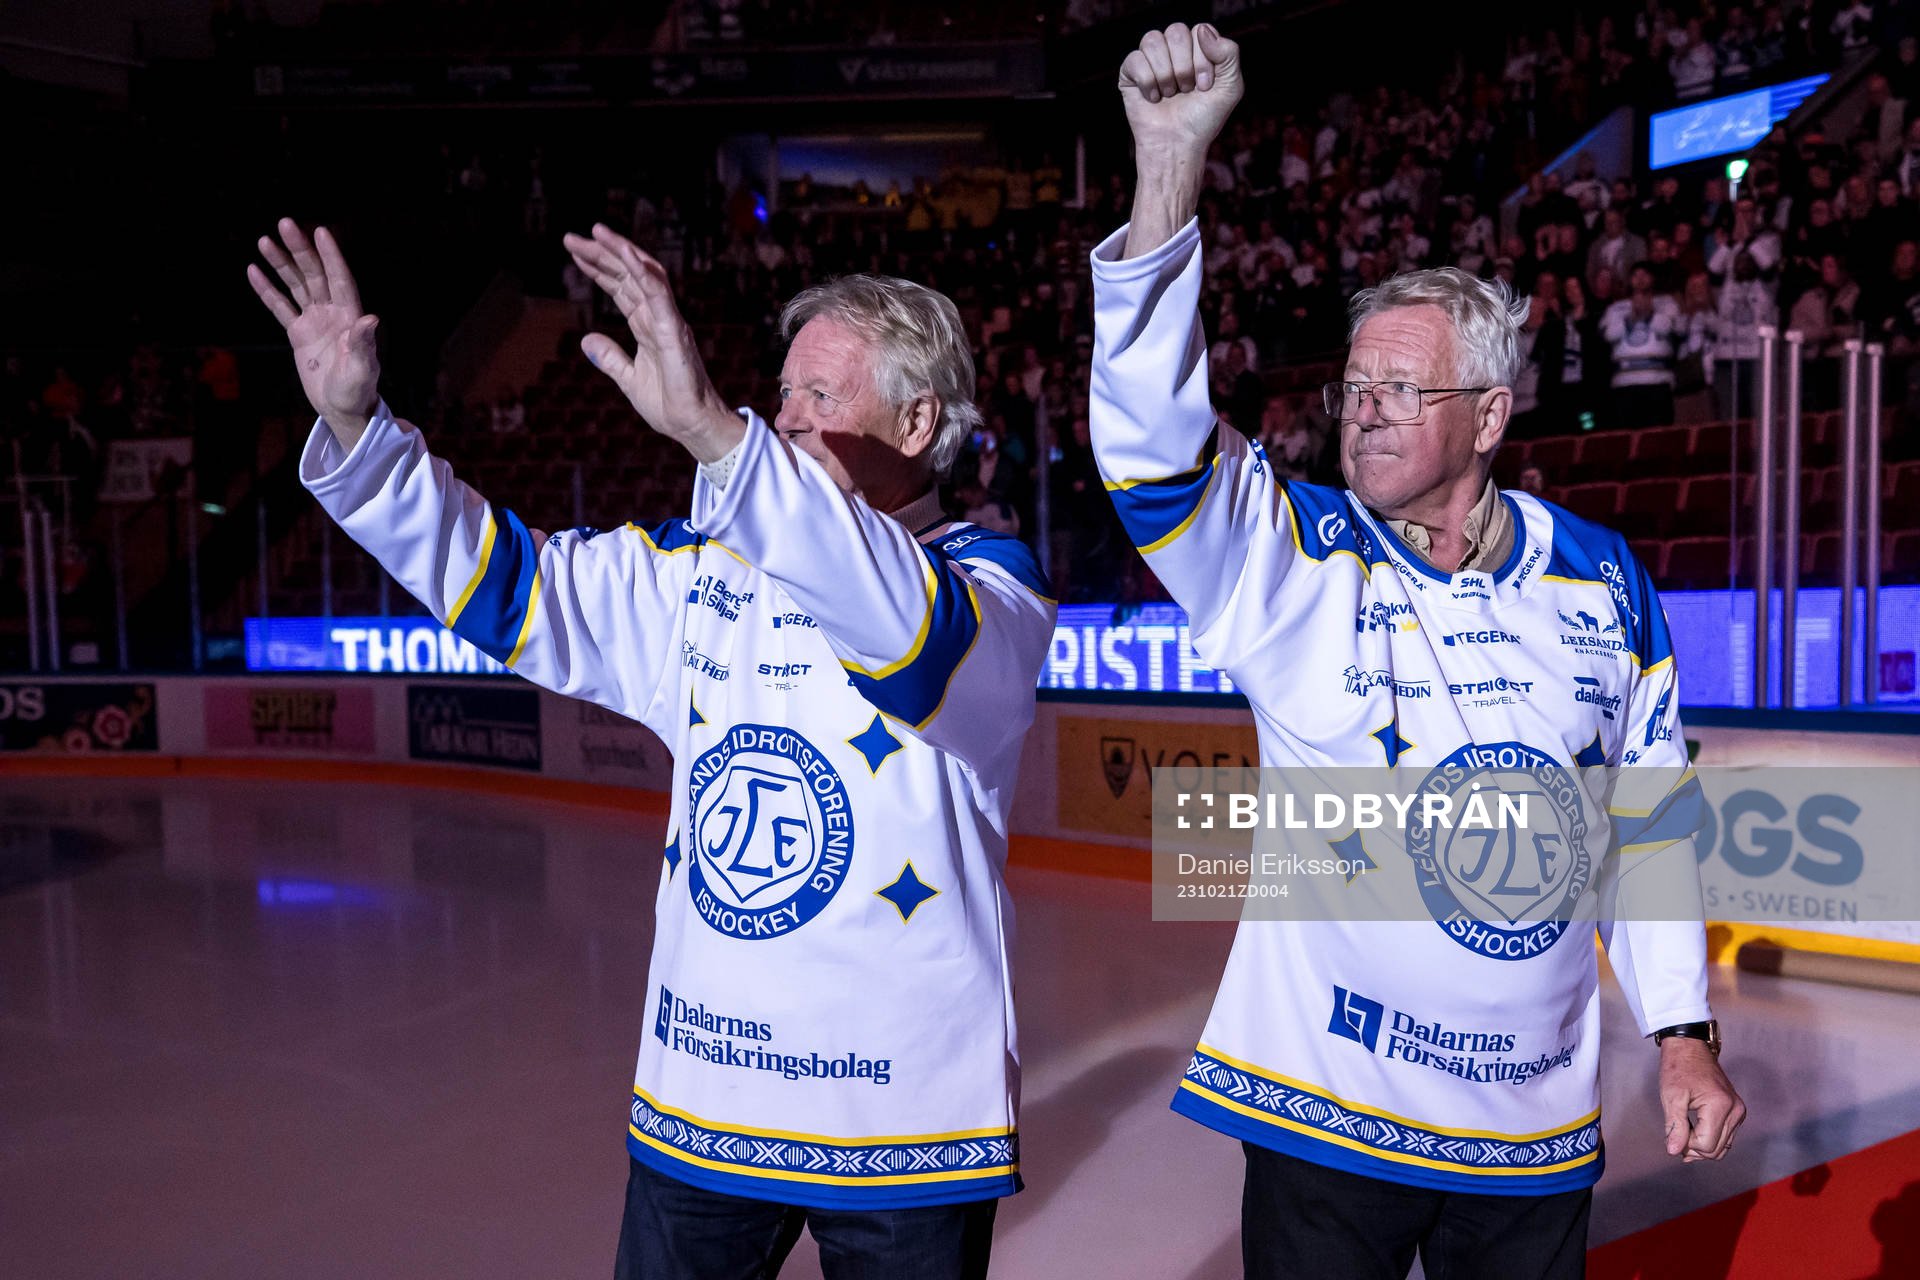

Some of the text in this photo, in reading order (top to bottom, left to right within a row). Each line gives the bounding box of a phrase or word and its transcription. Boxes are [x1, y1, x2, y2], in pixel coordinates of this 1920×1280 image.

[1460, 577, 1486, 589] SHL
[331, 628, 505, 673] THOM
[1037, 625, 1234, 693] RISTE
[1456, 630, 1520, 645] TEGERA
[1472, 696, 1516, 709] TRAVEL
[695, 888, 801, 936] ISHOCKEY
[1743, 890, 1858, 924] SWEDEN
[1443, 909, 1561, 957] ISHOCKEY
[674, 997, 772, 1042] Dalarnas
[1391, 1009, 1516, 1053] Dalarnas
[673, 1026, 893, 1085] Försäkringsbolag
[1385, 1033, 1576, 1085] Försäkringsbolag
